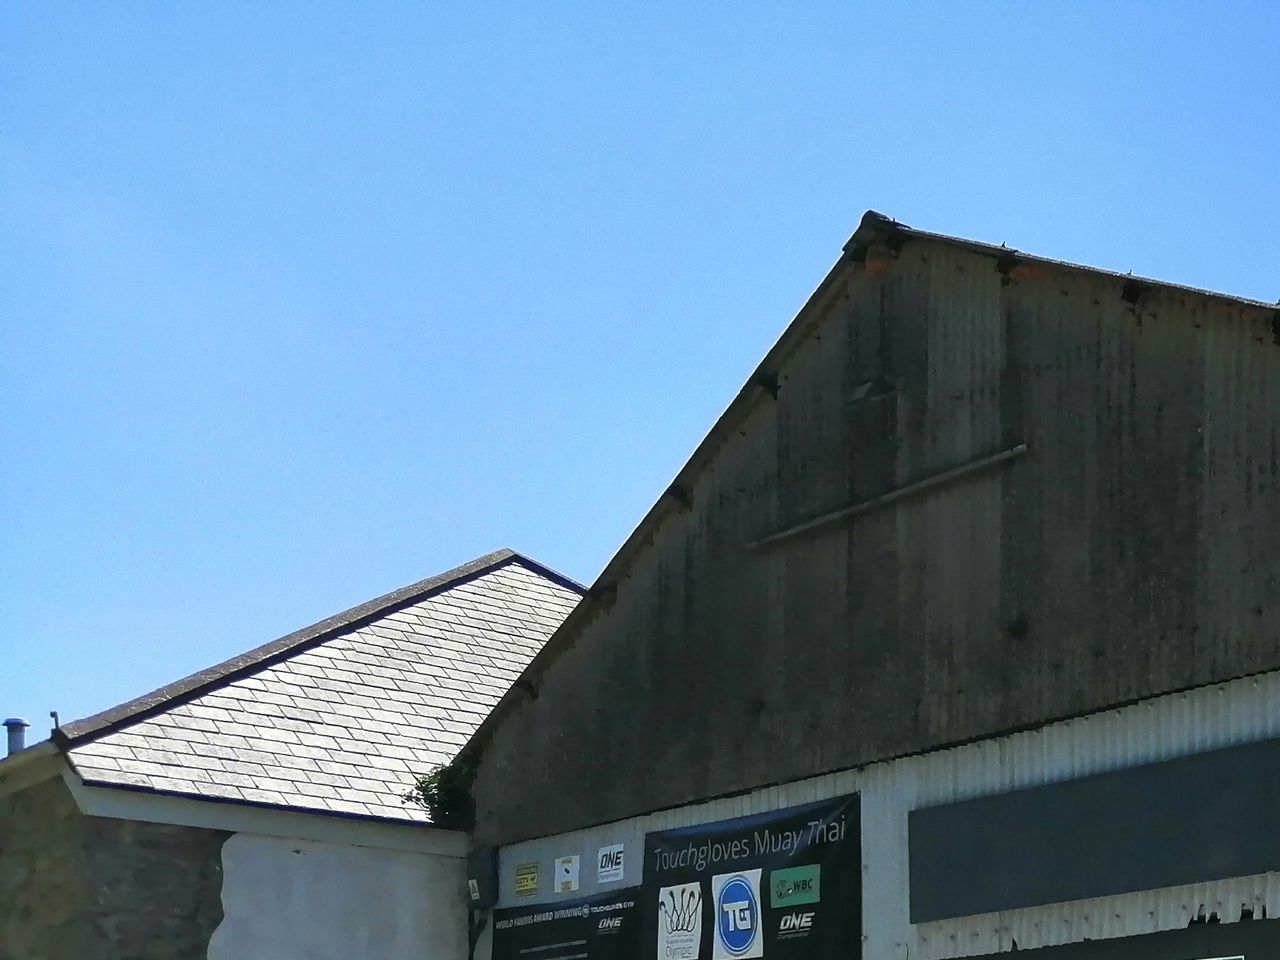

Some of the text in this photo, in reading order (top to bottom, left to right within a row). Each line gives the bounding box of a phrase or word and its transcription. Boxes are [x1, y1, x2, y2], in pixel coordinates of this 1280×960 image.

[654, 814, 846, 871] Touchgloves Muay Thai
[600, 849, 624, 869] ONE
[793, 879, 813, 891] WBC
[598, 916, 624, 928] ONE
[780, 912, 816, 930] ONE
